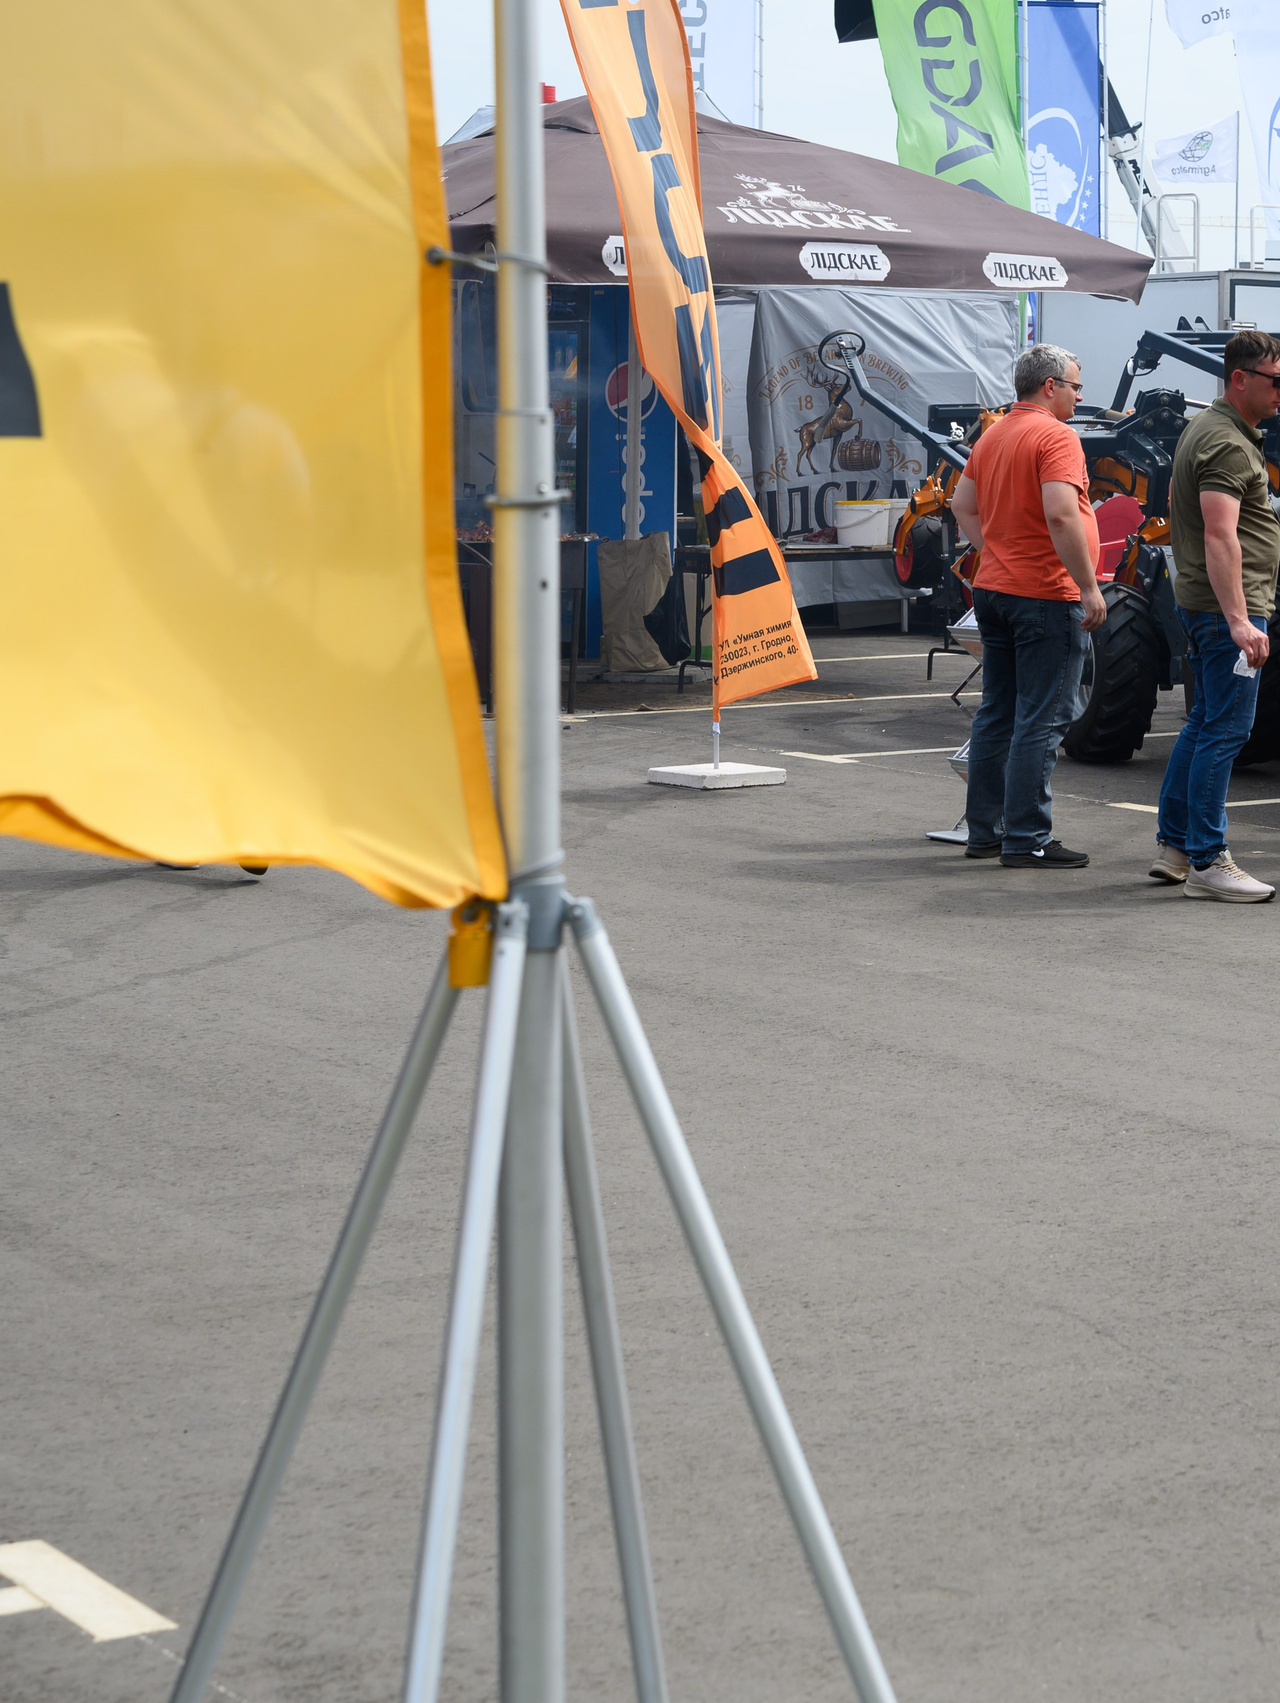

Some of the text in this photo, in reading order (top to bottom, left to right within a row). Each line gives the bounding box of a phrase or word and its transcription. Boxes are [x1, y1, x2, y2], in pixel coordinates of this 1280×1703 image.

[716, 206, 912, 233] ЛІДСКАЕ
[810, 252, 882, 271] ЛІДСКАЕ
[993, 262, 1060, 281] ЛІДСКАЕ
[759, 365, 790, 399] LEGEND
[789, 356, 801, 370] OF
[868, 353, 910, 391] BREWING
[798, 394, 814, 412] 18
[732, 629, 765, 645] «Умная
[766, 620, 792, 635] химия
[761, 634, 794, 651] Гродно,
[720, 652, 786, 680] Дзержинского,
